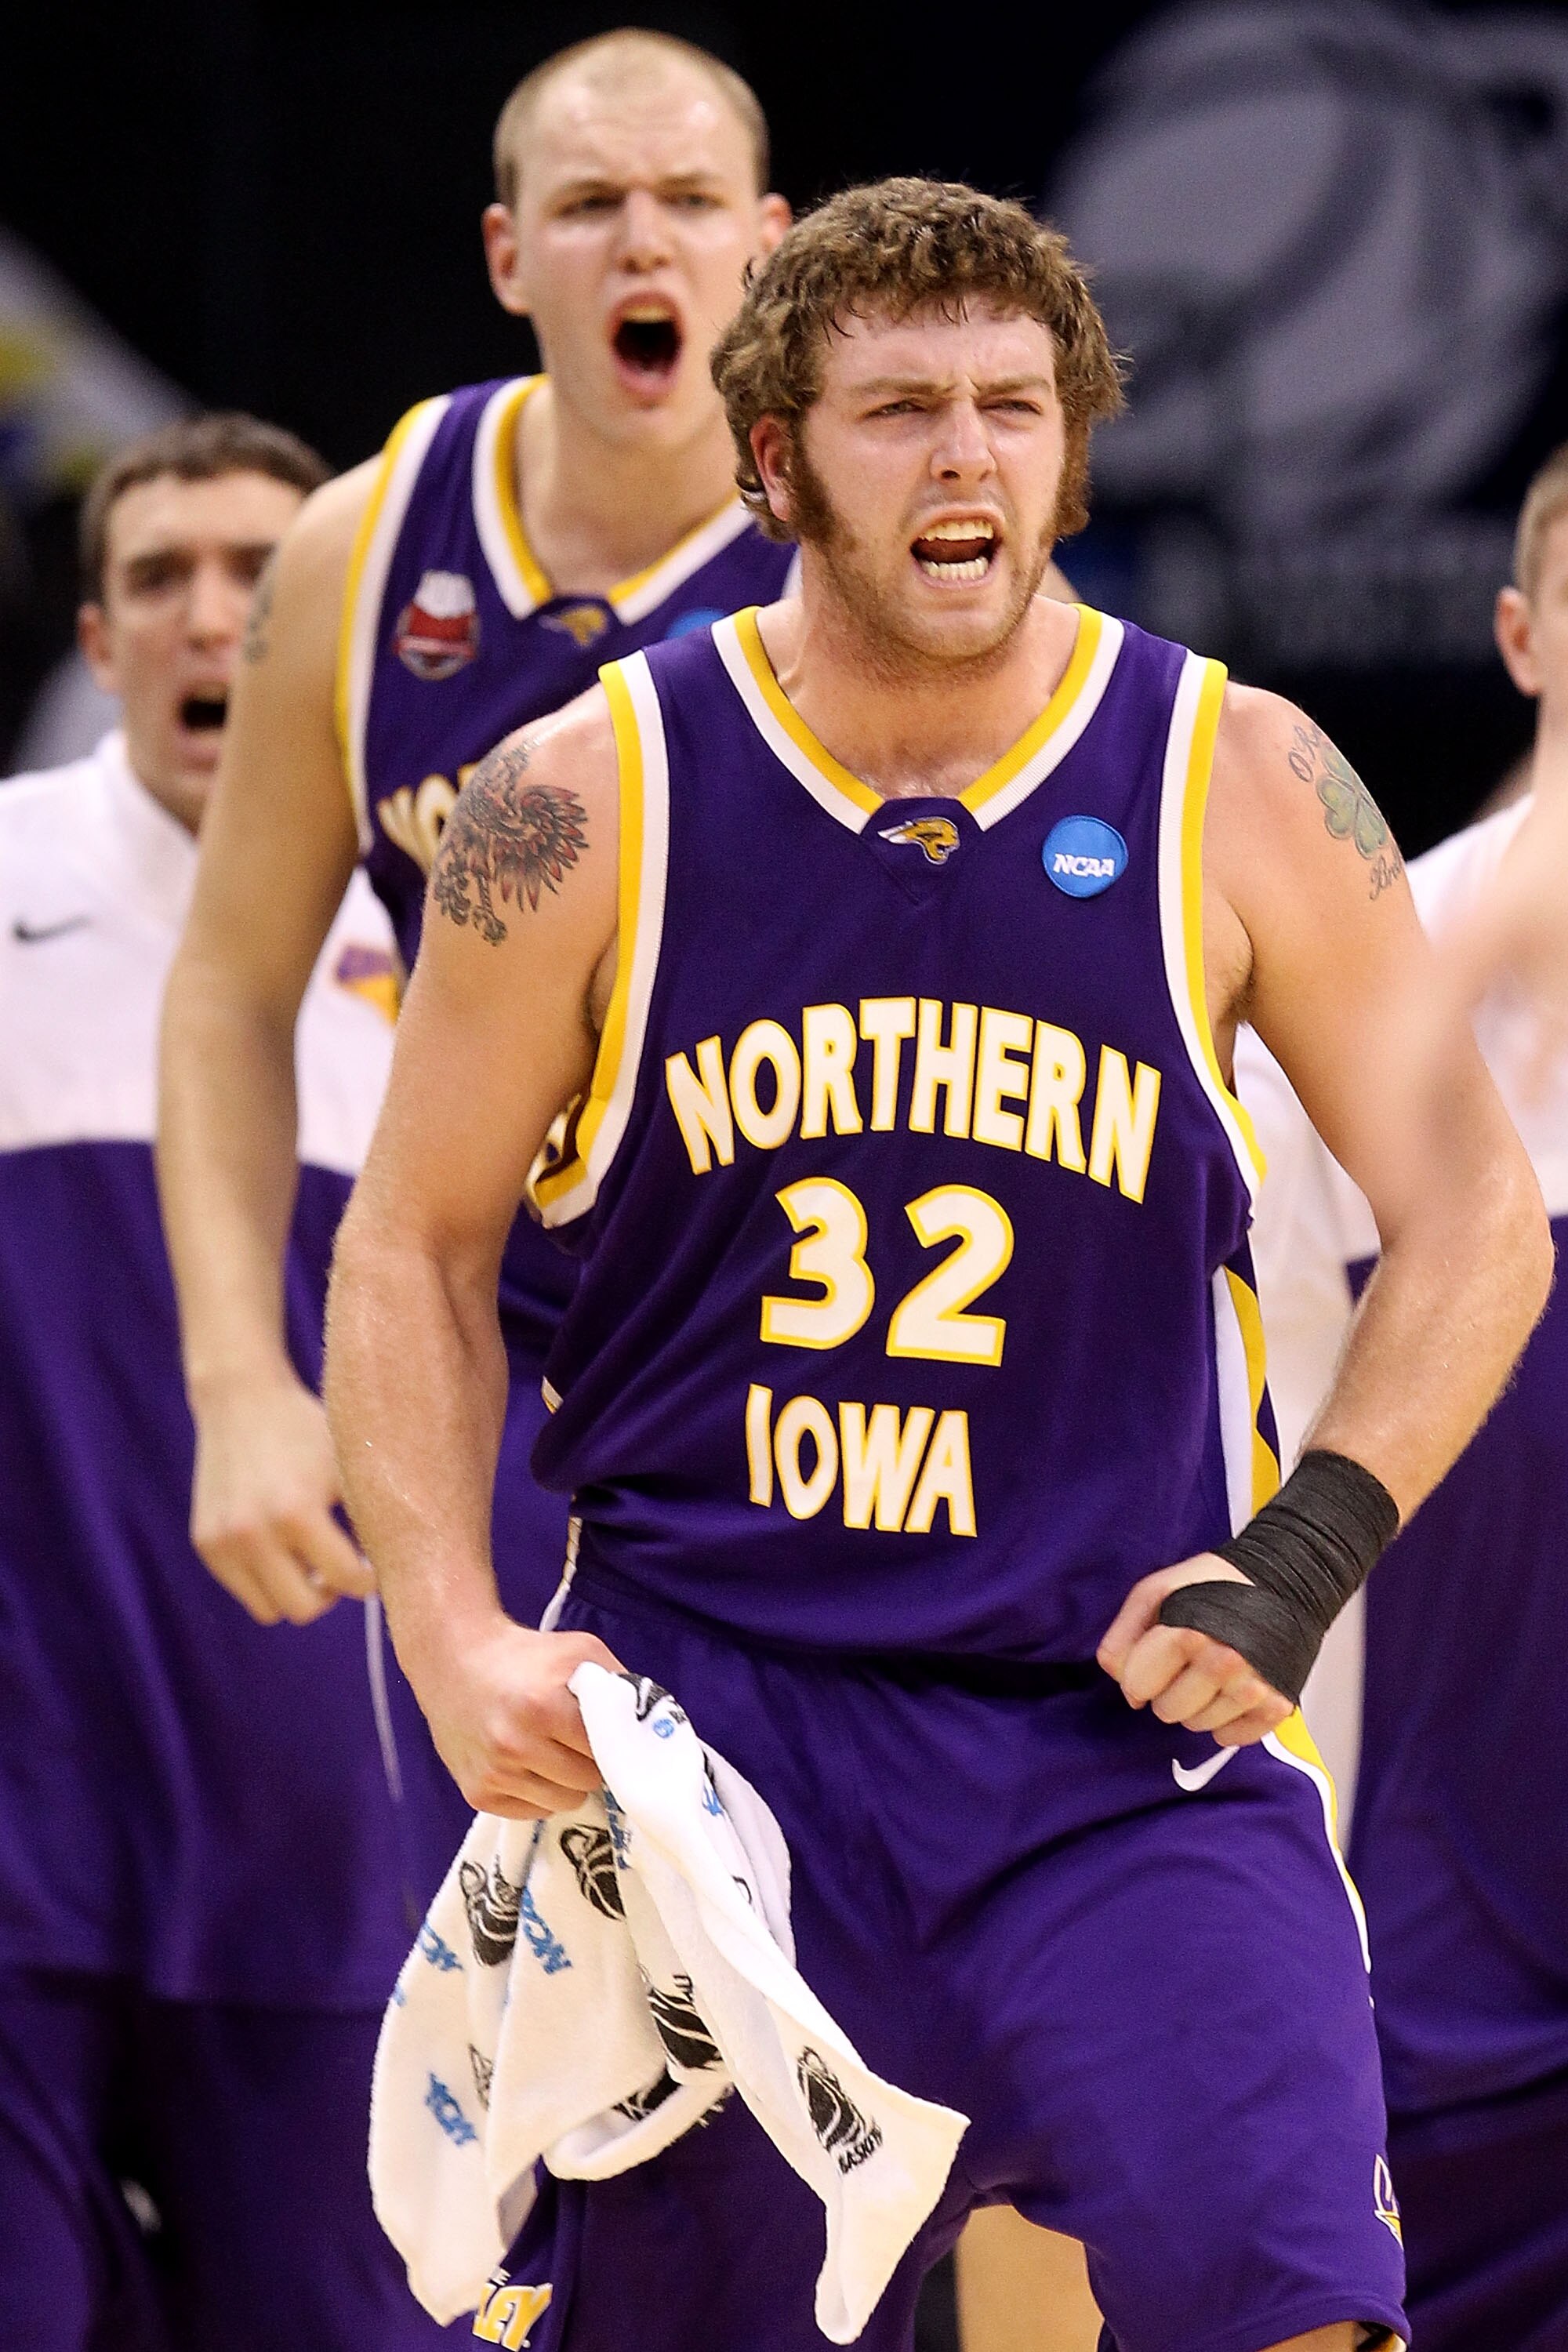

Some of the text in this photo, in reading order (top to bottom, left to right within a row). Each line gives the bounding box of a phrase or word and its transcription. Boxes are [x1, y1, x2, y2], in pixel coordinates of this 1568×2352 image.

[1053, 853, 1115, 877] NCAA
[665, 996, 1162, 1204] NORTHERN
[760, 1177, 1014, 1367] 32
[746, 1384, 978, 1537] IOWA
